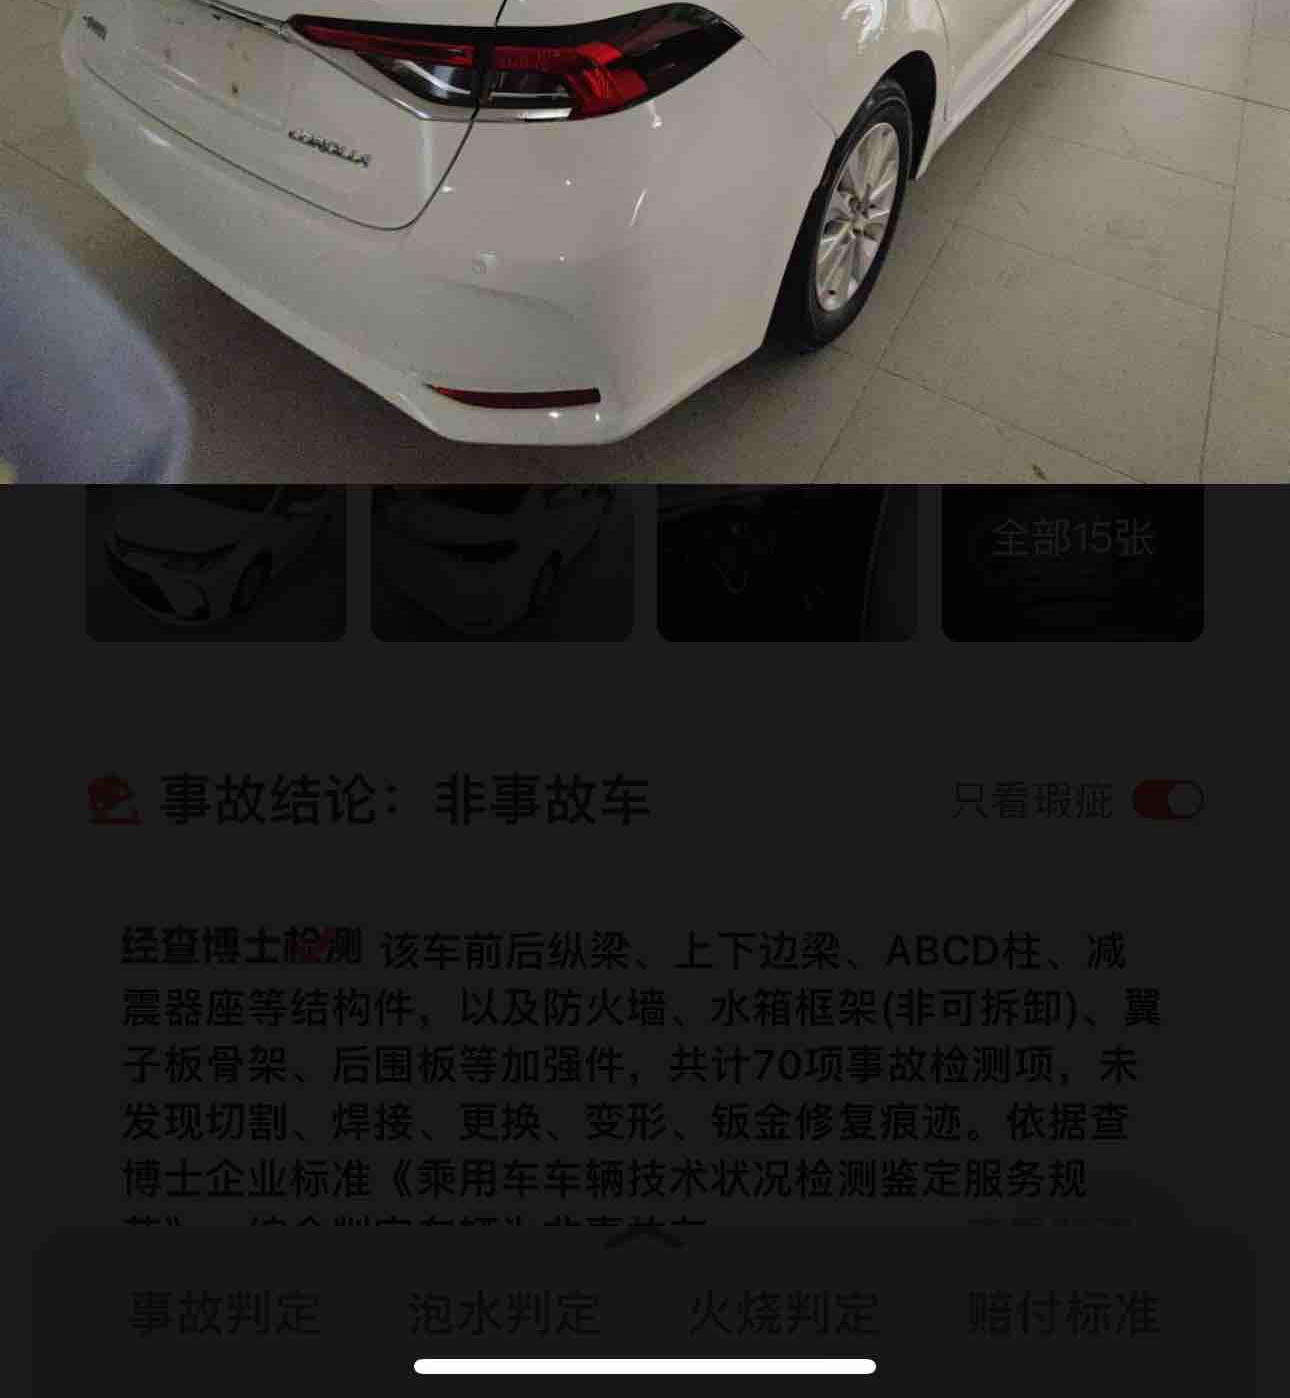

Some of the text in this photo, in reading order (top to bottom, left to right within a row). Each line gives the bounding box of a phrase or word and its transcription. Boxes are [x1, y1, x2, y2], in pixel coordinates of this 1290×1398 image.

[991, 516, 1156, 559] 全部15张
[160, 773, 651, 826] 事故结论：非事故车
[952, 779, 1114, 821] 只看瑕疵
[128, 1289, 322, 1337] 事故判定
[407, 1289, 602, 1337] 泡水判定
[687, 1289, 882, 1337] 火烧判定
[966, 1289, 1162, 1337] 赔付标准
